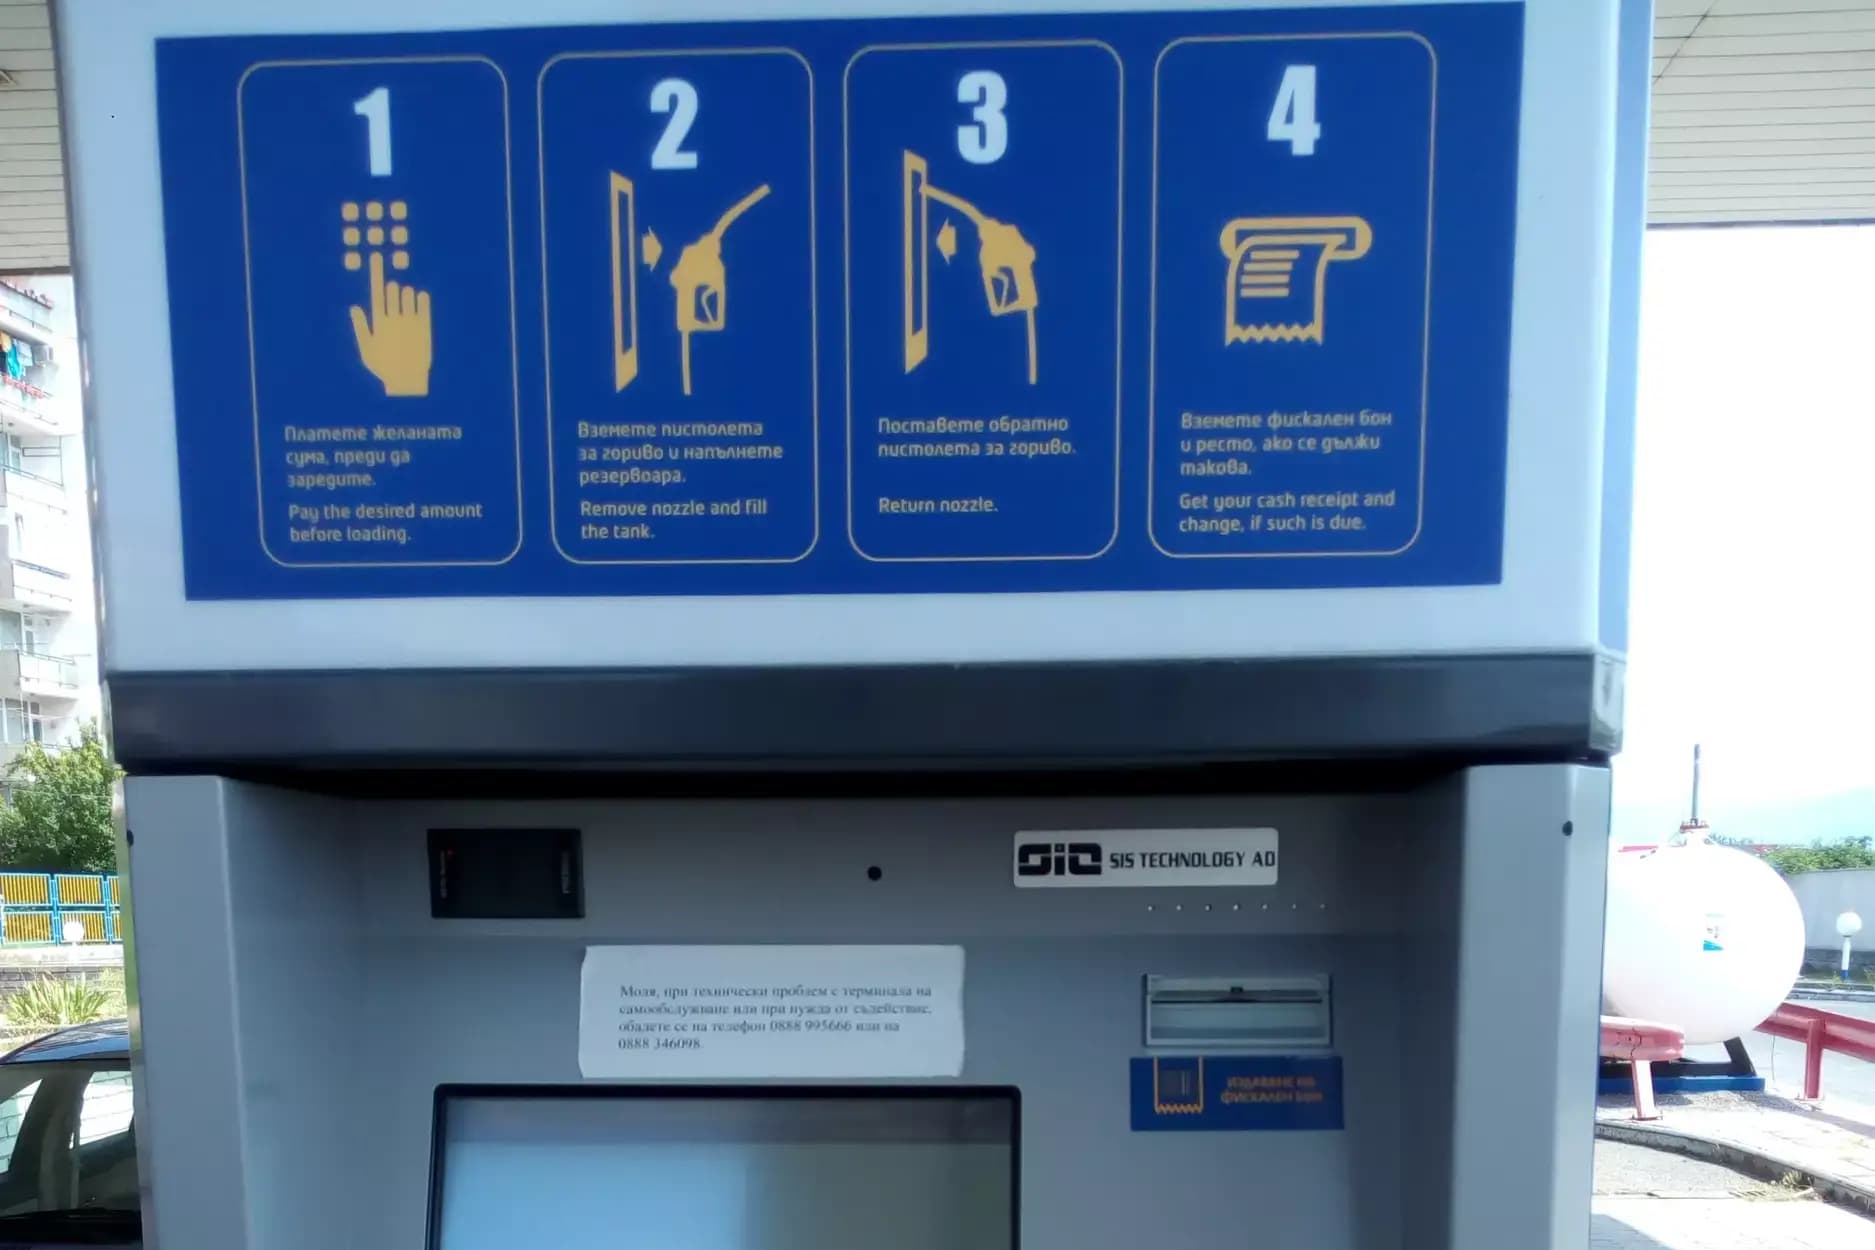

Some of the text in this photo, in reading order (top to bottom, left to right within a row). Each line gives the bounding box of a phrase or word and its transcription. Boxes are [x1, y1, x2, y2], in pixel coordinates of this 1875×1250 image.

[957, 70, 1008, 164] 3
[1267, 65, 1321, 156] 4
[354, 88, 393, 177] 1
[650, 78, 699, 170] 2
[879, 416, 1068, 435] Поставете обратно
[1181, 409, 1392, 431] Вземете фискален бон
[284, 425, 462, 442] Платете желаната
[578, 422, 763, 438] Вземете пистолета
[879, 438, 1076, 459] пистолета за гориво.
[1181, 439, 1190, 452] и
[1263, 435, 1292, 451] ако
[1298, 436, 1316, 450] се
[1322, 433, 1380, 453] дължи
[334, 450, 385, 467] преди
[390, 450, 410, 467] да
[579, 444, 783, 463] за гориво и напълнете
[580, 467, 686, 486] резервоара.
[1180, 459, 1251, 476] такова.
[288, 473, 376, 490] заредите.
[580, 498, 767, 516] Remove nozzle and fill
[879, 496, 998, 513] Return nozzle.
[1180, 490, 1395, 512] Get your cash receipt and
[288, 504, 482, 523] Pay the desired amount
[581, 524, 655, 539] the tank.
[1179, 514, 1366, 535] change, if such is due.
[290, 527, 412, 544] before loading.
[1110, 853, 1134, 869] SIS
[1141, 852, 1245, 868] TECHNOLOGY
[1252, 851, 1275, 867] AD
[620, 985, 660, 998] Моля,
[664, 988, 688, 1000] при
[694, 988, 767, 997] технически
[772, 984, 827, 999] проблем
[842, 988, 912, 998] терминала
[916, 989, 932, 997] на
[733, 1005, 757, 1014] или
[761, 1005, 785, 1016] при
[790, 1005, 831, 1016] нужда
[835, 1005, 848, 1014] от
[674, 1024, 688, 1032] се
[692, 1024, 707, 1032] на
[712, 1020, 765, 1034] телефон
[770, 1020, 800, 1032] 0888
[805, 1020, 851, 1032] 995666
[885, 1023, 899, 1031] на
[618, 1038, 649, 1049] 0888
